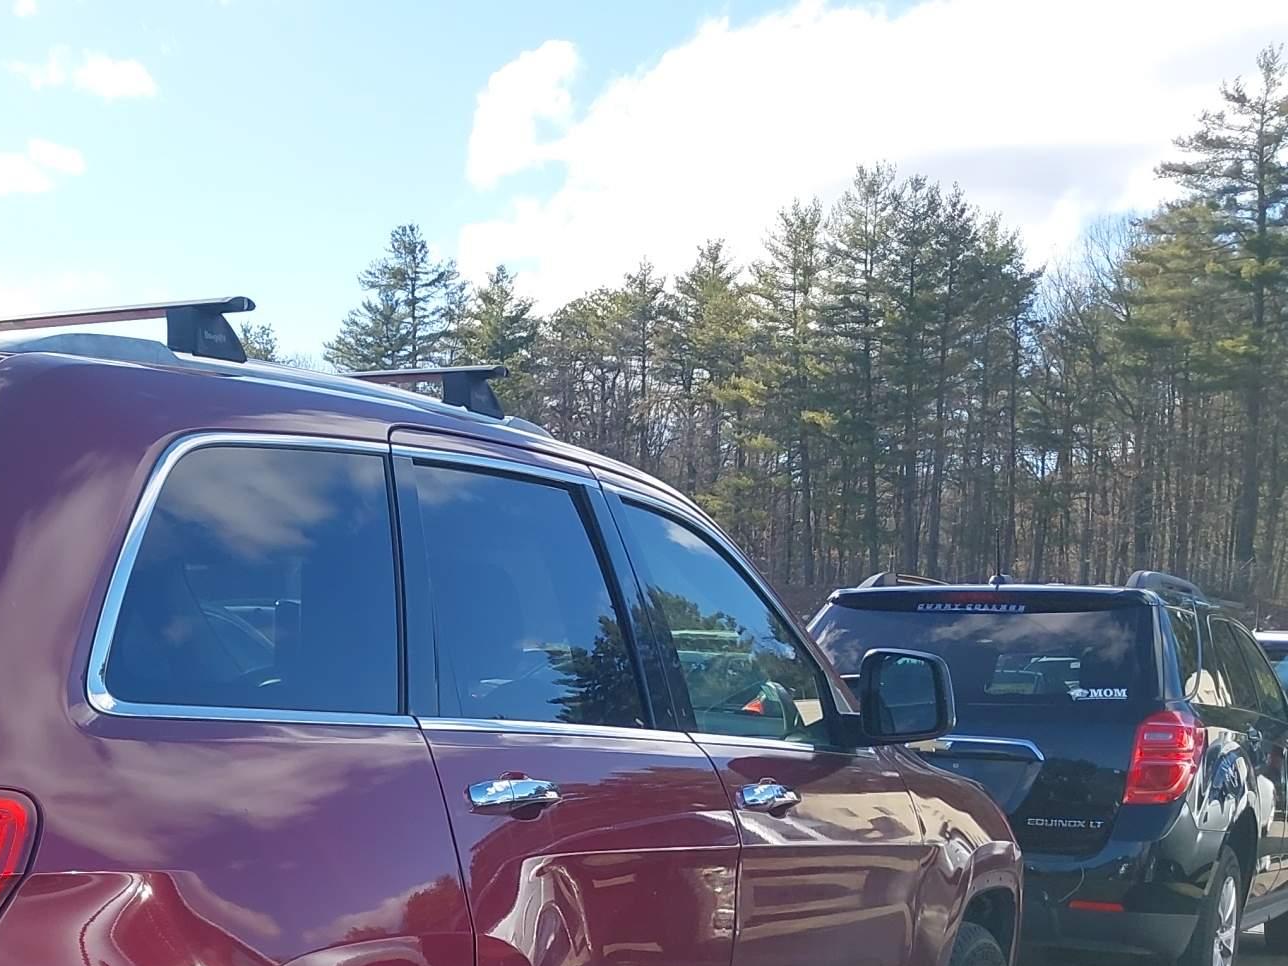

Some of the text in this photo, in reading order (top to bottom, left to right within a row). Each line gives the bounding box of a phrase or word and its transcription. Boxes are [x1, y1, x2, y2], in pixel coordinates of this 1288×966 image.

[1089, 688, 1128, 698] MOM
[1027, 817, 1105, 829] EQUINOX LT
